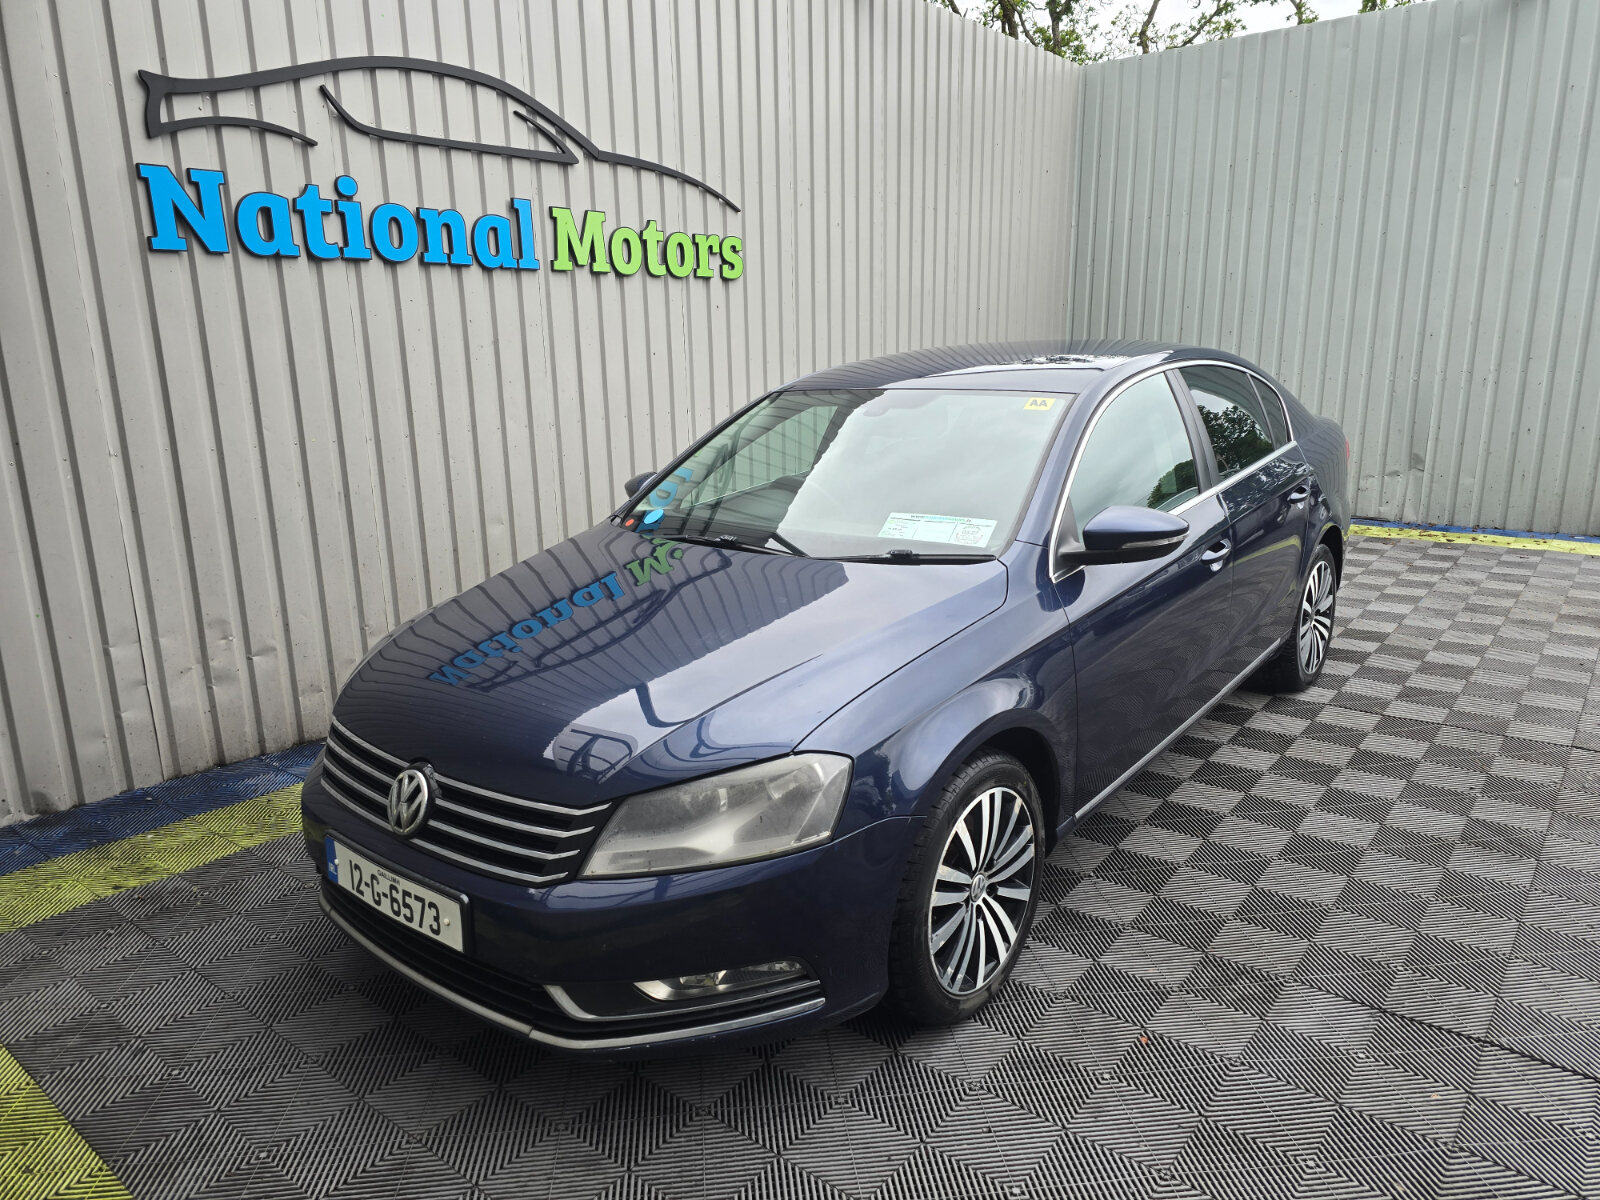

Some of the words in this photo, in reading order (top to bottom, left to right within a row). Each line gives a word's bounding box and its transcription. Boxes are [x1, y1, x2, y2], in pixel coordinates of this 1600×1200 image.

[137, 163, 540, 270] National
[550, 206, 744, 280] Motors
[1029, 398, 1048, 408] AA
[349, 859, 442, 937] 12-G-6573
